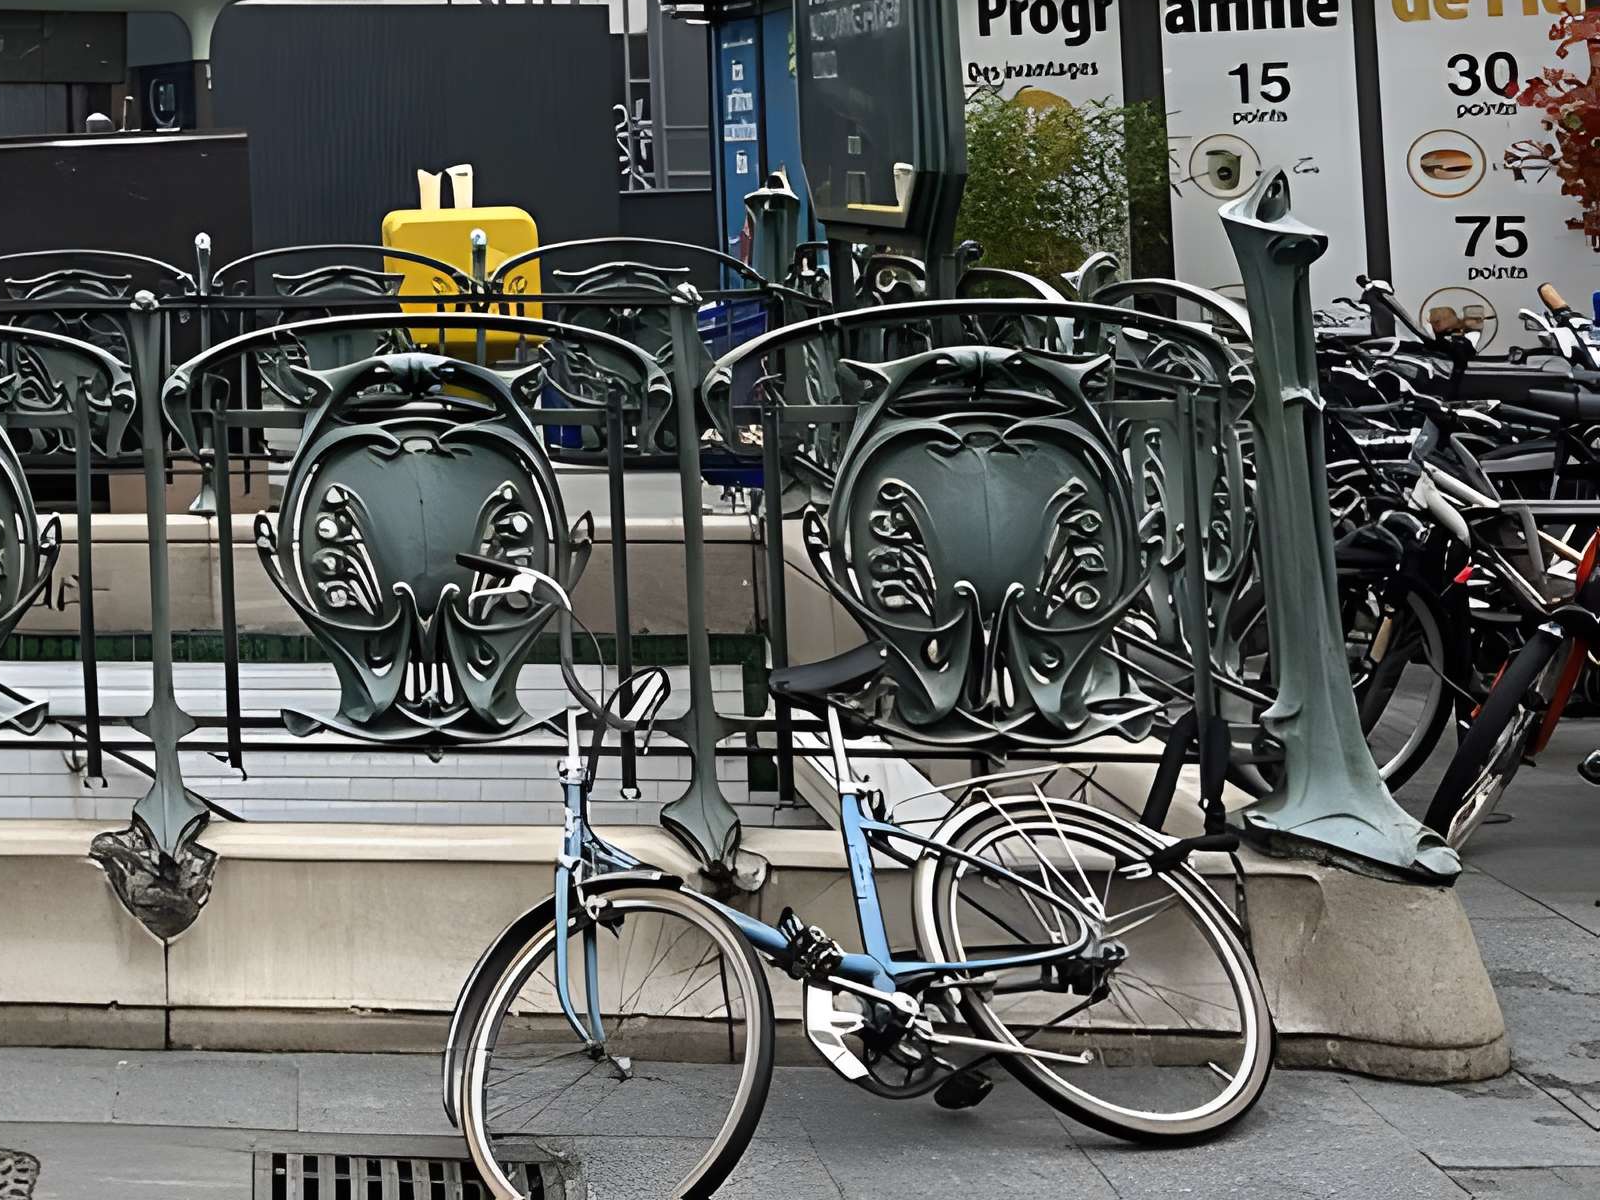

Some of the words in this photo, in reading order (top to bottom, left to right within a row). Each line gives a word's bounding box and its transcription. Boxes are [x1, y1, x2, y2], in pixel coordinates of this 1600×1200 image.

[1227, 61, 1291, 105] 15
[1446, 51, 1520, 100] 30
[1455, 215, 1529, 259] 75
